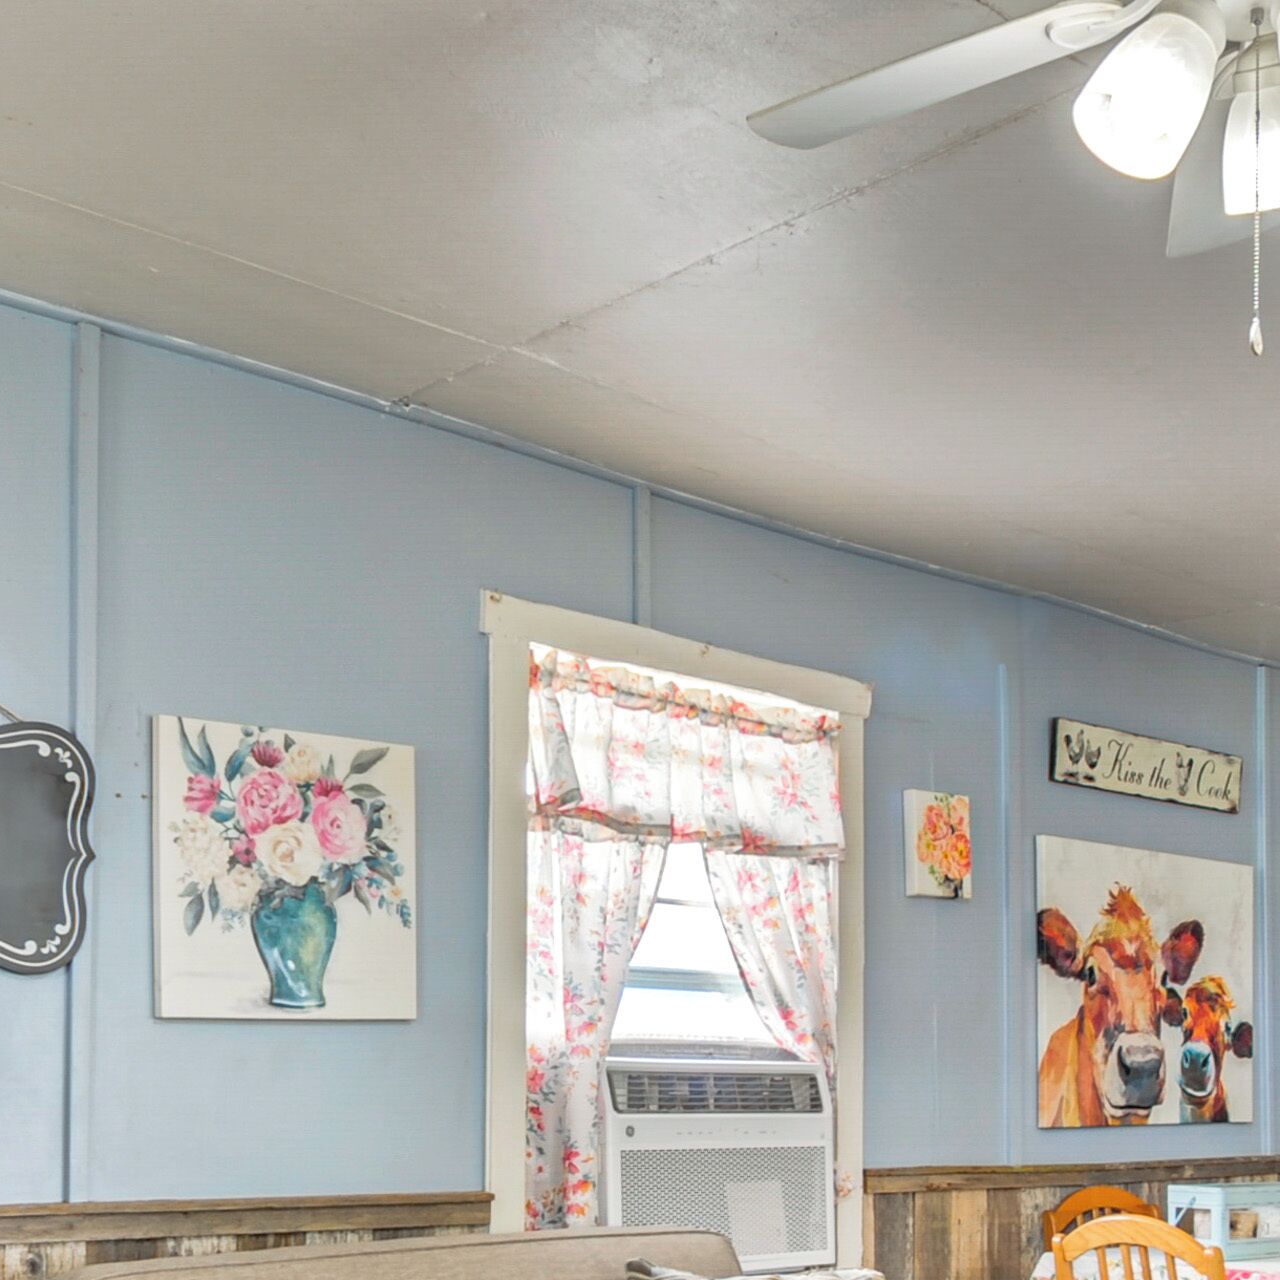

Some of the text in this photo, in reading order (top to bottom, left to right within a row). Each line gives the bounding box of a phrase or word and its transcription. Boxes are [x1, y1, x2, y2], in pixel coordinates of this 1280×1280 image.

[1102, 739, 1232, 800] Kiss the Cook
